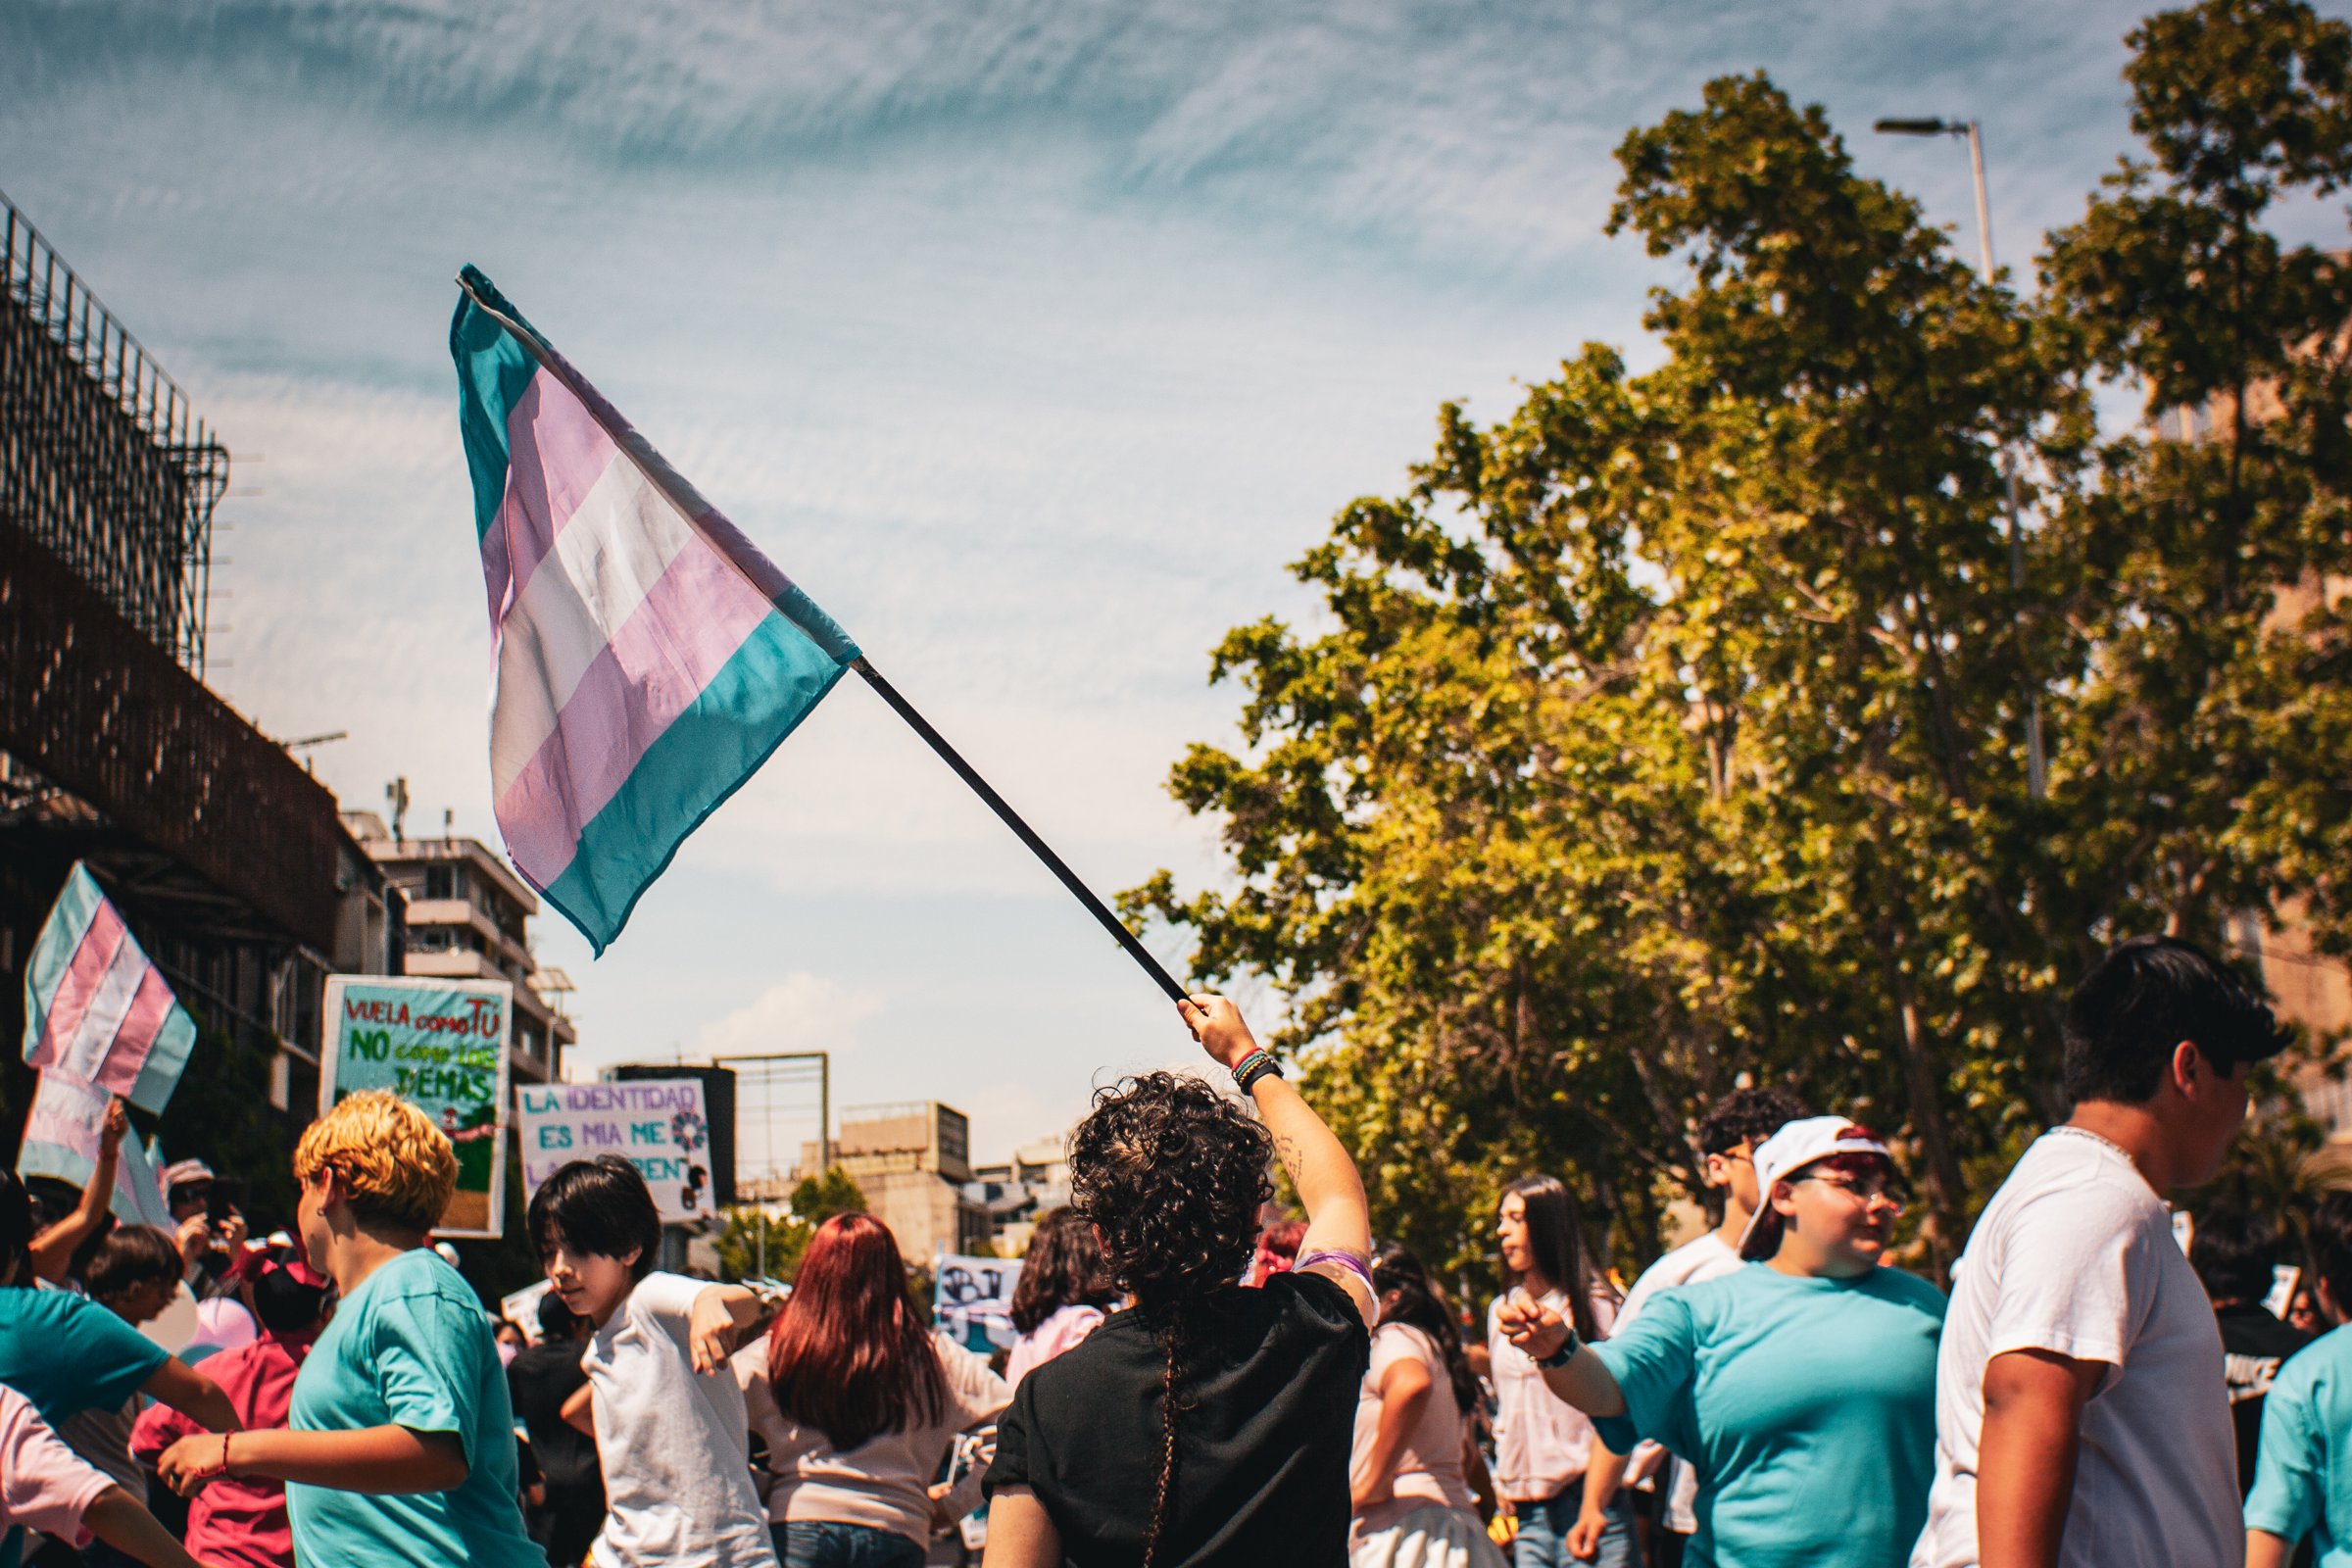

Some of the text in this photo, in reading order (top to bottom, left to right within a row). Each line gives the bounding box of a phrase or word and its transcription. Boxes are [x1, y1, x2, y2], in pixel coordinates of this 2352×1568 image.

[345, 998, 410, 1026] VUELA
[350, 1029, 391, 1060] NO
[523, 1085, 697, 1114] LA IDENTIDAD
[539, 1121, 665, 1149] ES MIA ME
